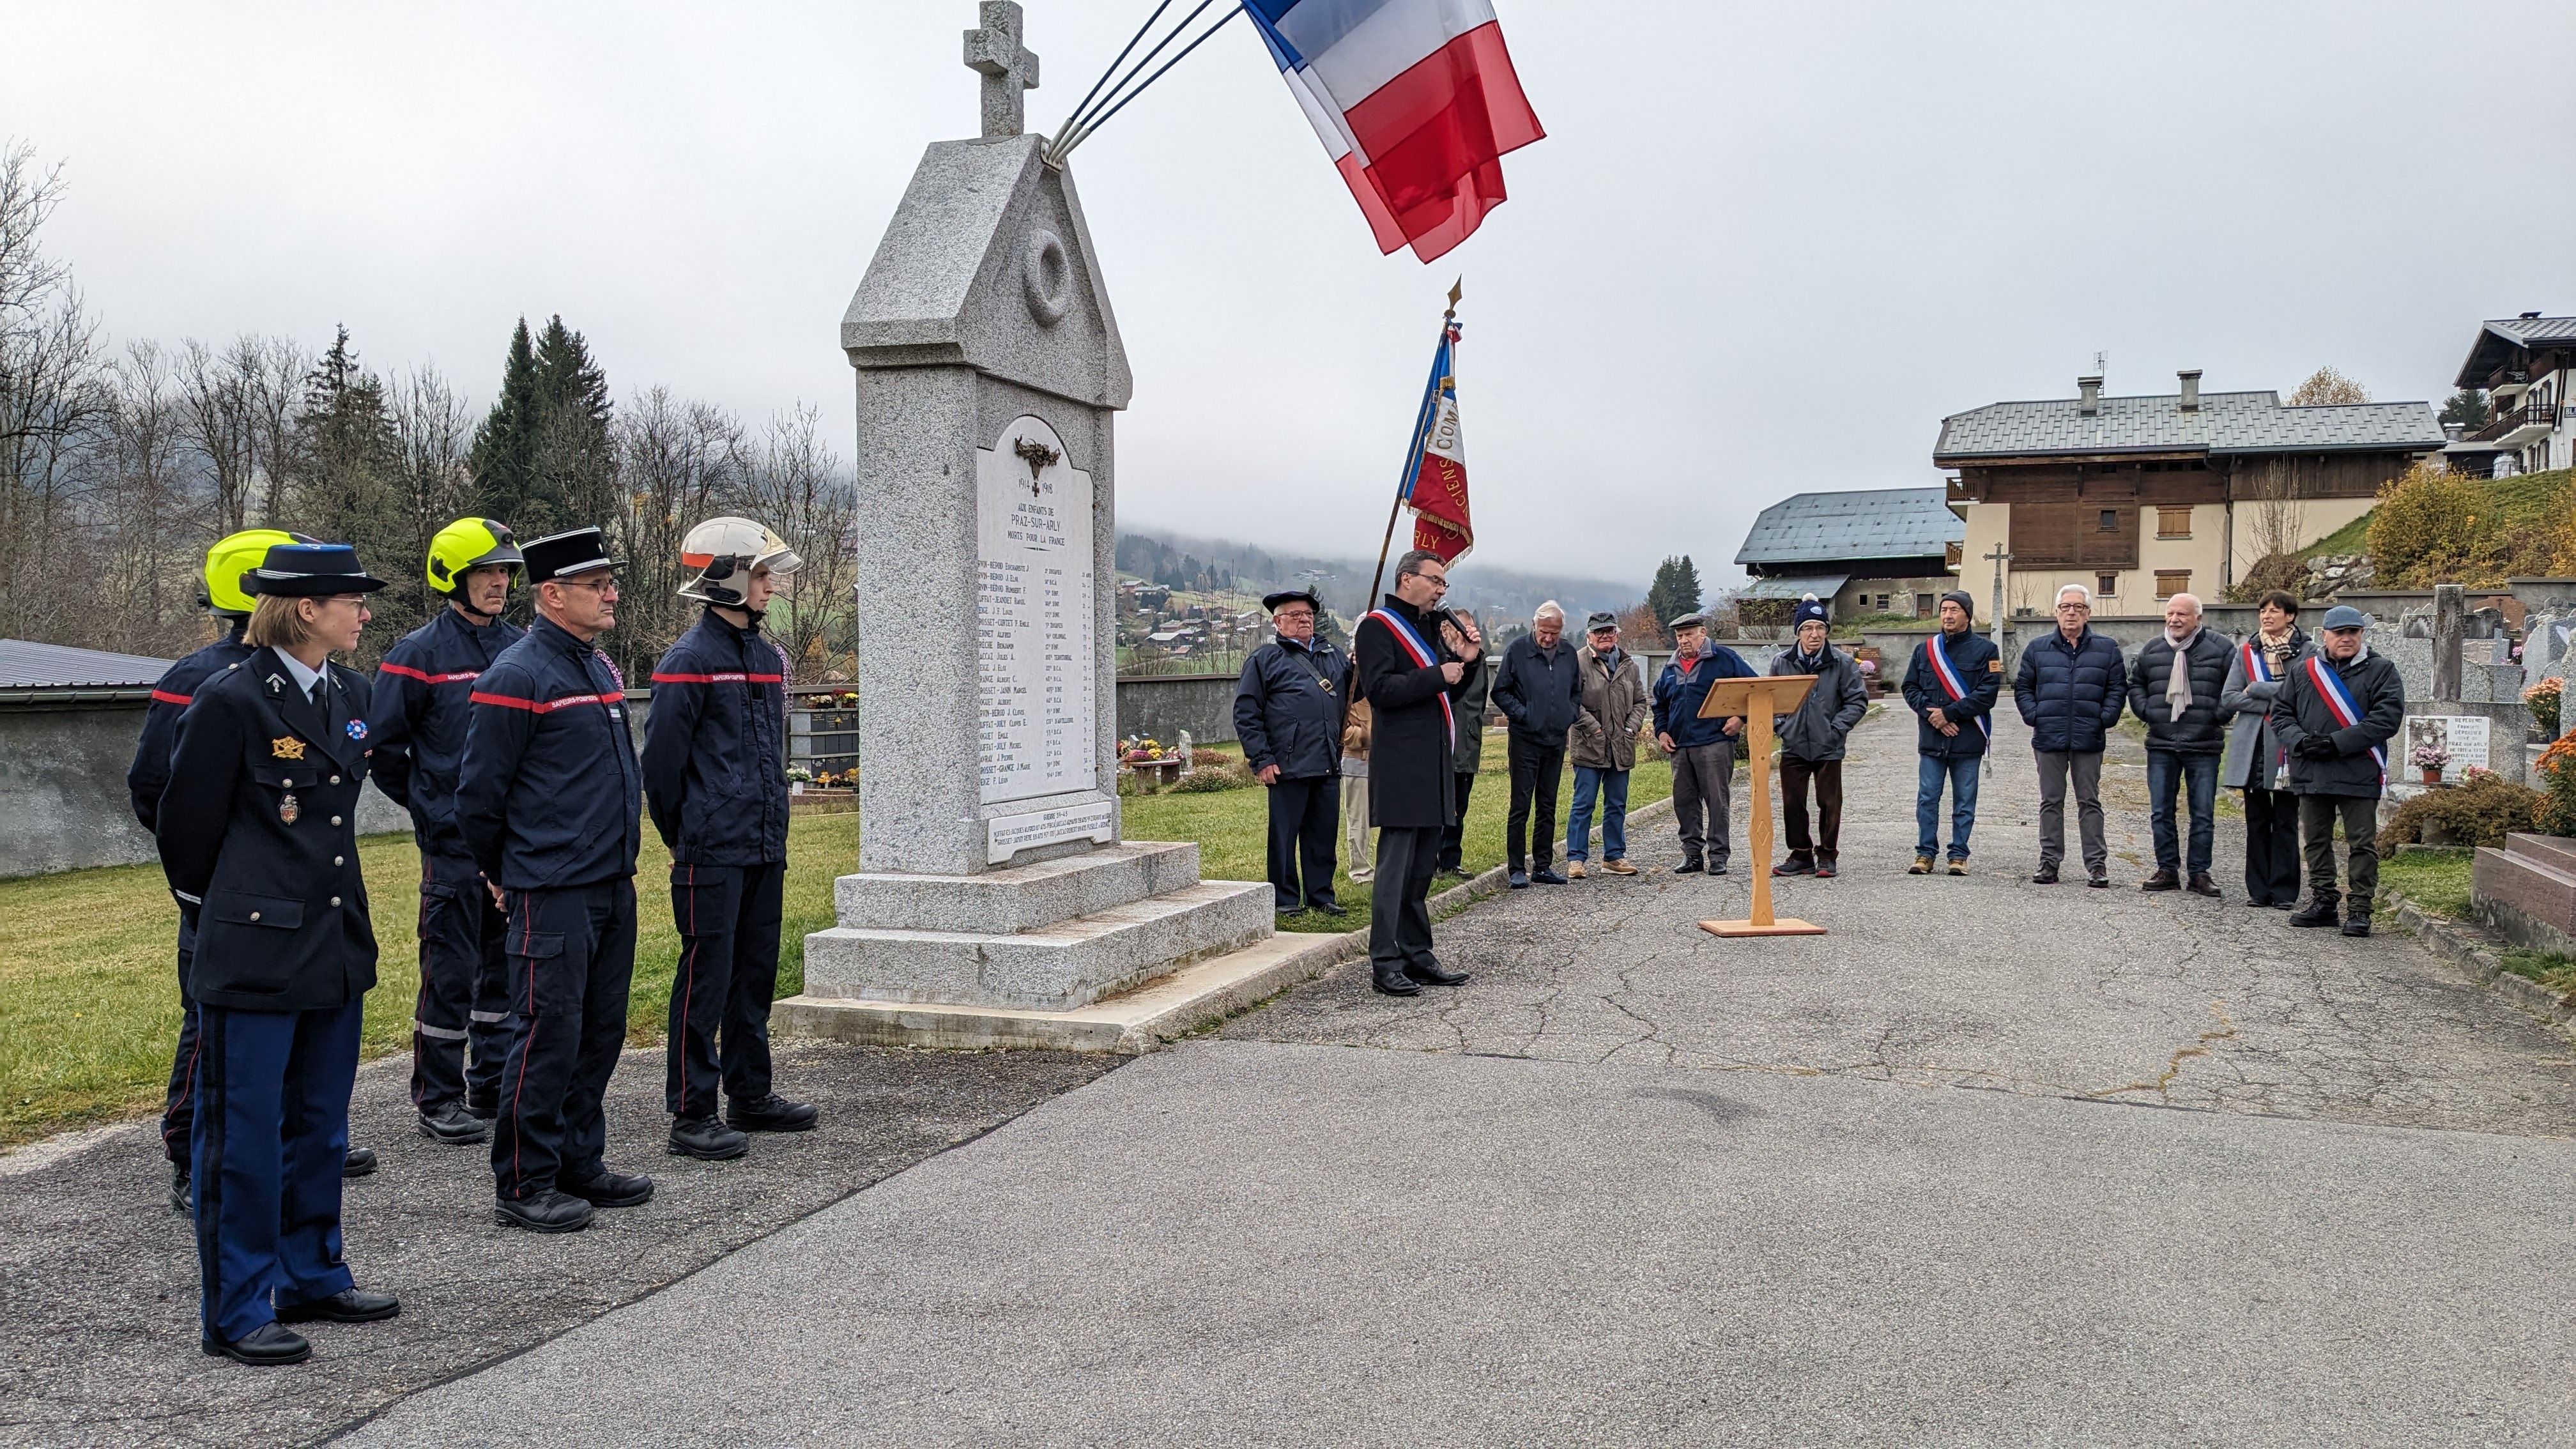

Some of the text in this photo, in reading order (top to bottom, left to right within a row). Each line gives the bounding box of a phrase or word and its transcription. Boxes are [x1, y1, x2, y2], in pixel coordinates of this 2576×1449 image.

[2564, 407, 2576, 416] BL
[1018, 478, 1053, 494] 1914 1918
[1018, 503, 1054, 516] AUX ENFANTS DE
[1011, 514, 1061, 532] PRAZ-SUR-ARLY
[1008, 530, 1065, 546] MORTS POUR LA FRANCE
[1414, 530, 1440, 549] RLY
